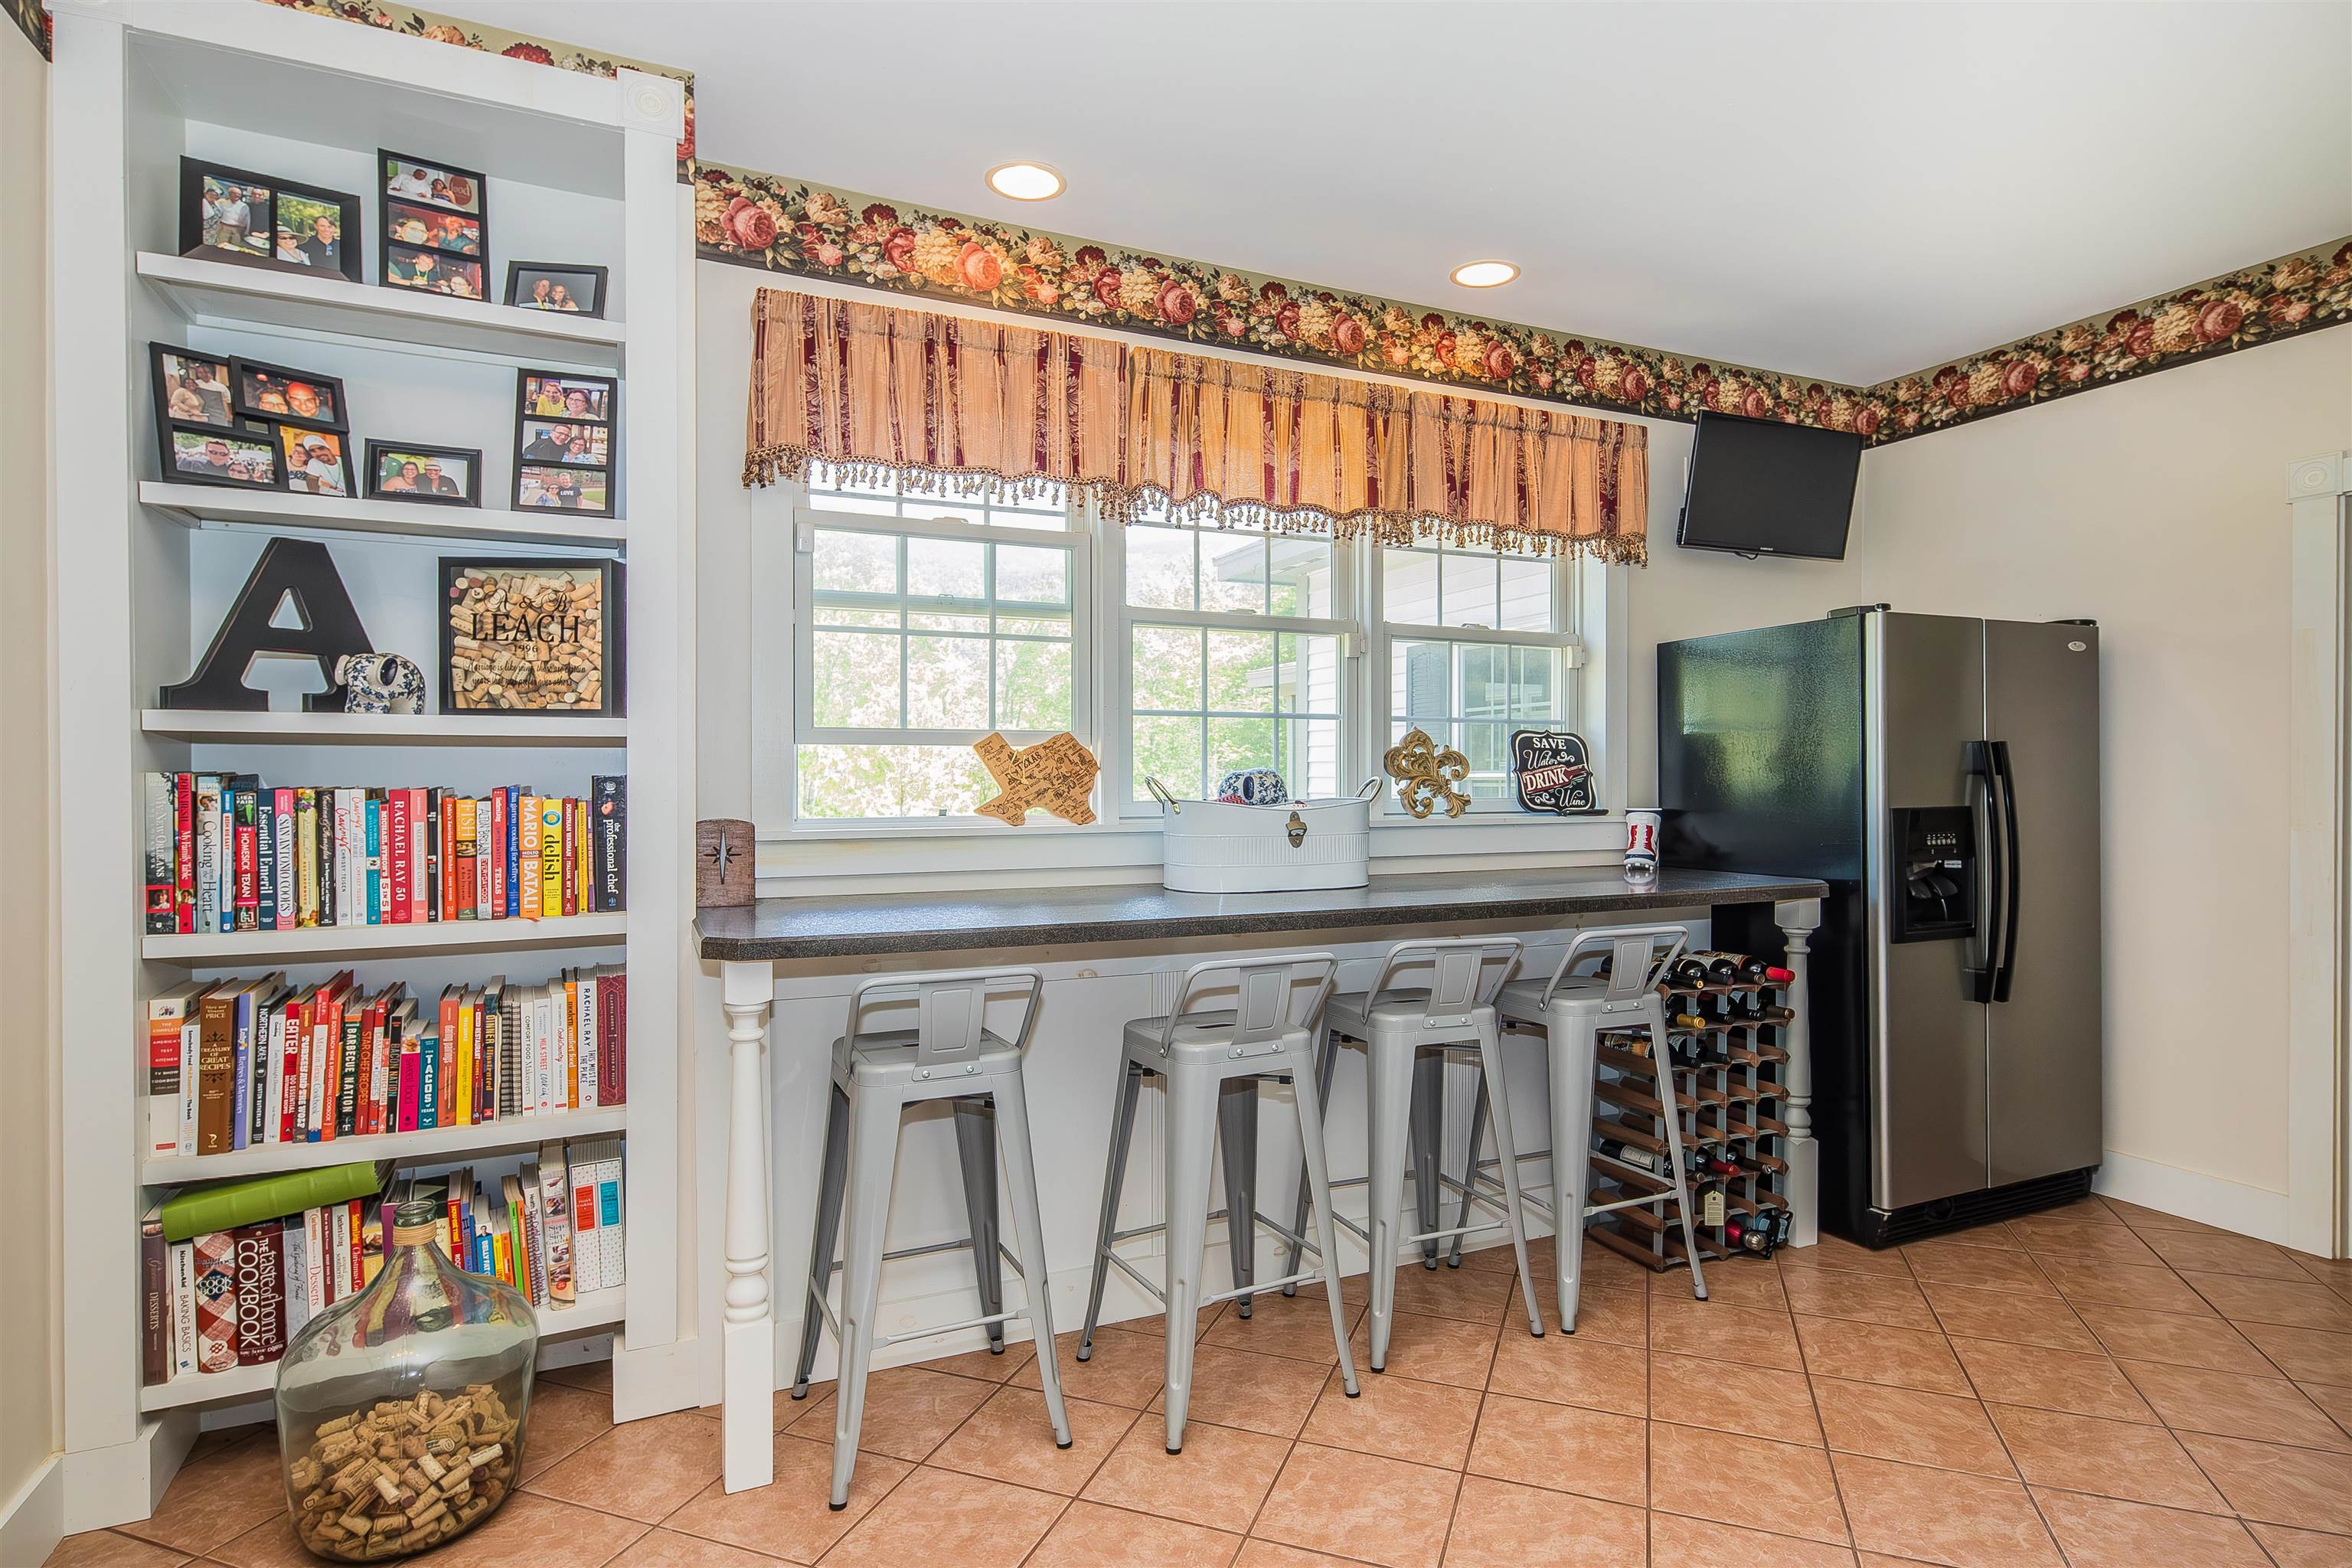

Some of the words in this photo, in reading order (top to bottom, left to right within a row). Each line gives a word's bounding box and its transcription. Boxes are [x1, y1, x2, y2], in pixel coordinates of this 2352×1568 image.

[471, 612, 581, 643] LEACH
[514, 644, 538, 652] 1996
[505, 661, 517, 671] like
[1533, 738, 1566, 750] SAVE
[1015, 752, 1042, 770] TEXAS
[1524, 750, 1559, 769] Water
[181, 777, 189, 799] JOHN
[1524, 768, 1570, 792] DRINK
[1555, 788, 1586, 807] Wine
[181, 800, 189, 822] BESH
[460, 804, 475, 837] FISH
[479, 808, 489, 828] ALTON
[179, 831, 191, 841] My
[259, 806, 273, 854] Essential
[394, 801, 405, 856] RACHAEL
[524, 800, 538, 848] MARIO
[179, 841, 191, 863] Family
[199, 821, 217, 868] Cooking
[241, 833, 250, 871] HOMESICK
[479, 829, 490, 855] BROWN
[603, 819, 616, 872] professional
[544, 835, 560, 881] delish
[181, 864, 191, 880] Table
[260, 858, 273, 893] Emeril
[395, 861, 405, 884] RAY
[523, 861, 539, 908] BATALI
[607, 874, 619, 893] chef
[202, 882, 220, 913] Heart
[242, 873, 250, 897] TEXAN
[396, 887, 406, 900] 50
[257, 1008, 268, 1044] NORTHERN
[285, 1019, 299, 1054] EATER
[444, 1025, 455, 1041] daring
[485, 1014, 495, 1044] DINNER
[345, 1028, 356, 1073] BARBECUE
[362, 1031, 371, 1049] STAR
[373, 1032, 381, 1066] DIAMOND
[301, 1035, 309, 1073] TURKEY
[360, 1051, 370, 1073] CHEF
[390, 1044, 400, 1069] BACON
[443, 1043, 454, 1063] pairings
[568, 1054, 577, 1068] food
[299, 1074, 308, 1088] AND
[388, 1071, 398, 1096] NATION
[299, 1089, 307, 1105] THE
[312, 1083, 321, 1115] Cookbook
[342, 1077, 354, 1112] NATION
[297, 1106, 305, 1128] WOLF
[259, 1237, 269, 1254] THE
[352, 1247, 361, 1279] Christmas
[238, 1240, 260, 1348] COOKBOOK
[310, 1266, 321, 1306] Desserts
[149, 1292, 159, 1330] DESSERTS
[179, 1295, 190, 1324] BAKING
[181, 1326, 191, 1352] BASICS
